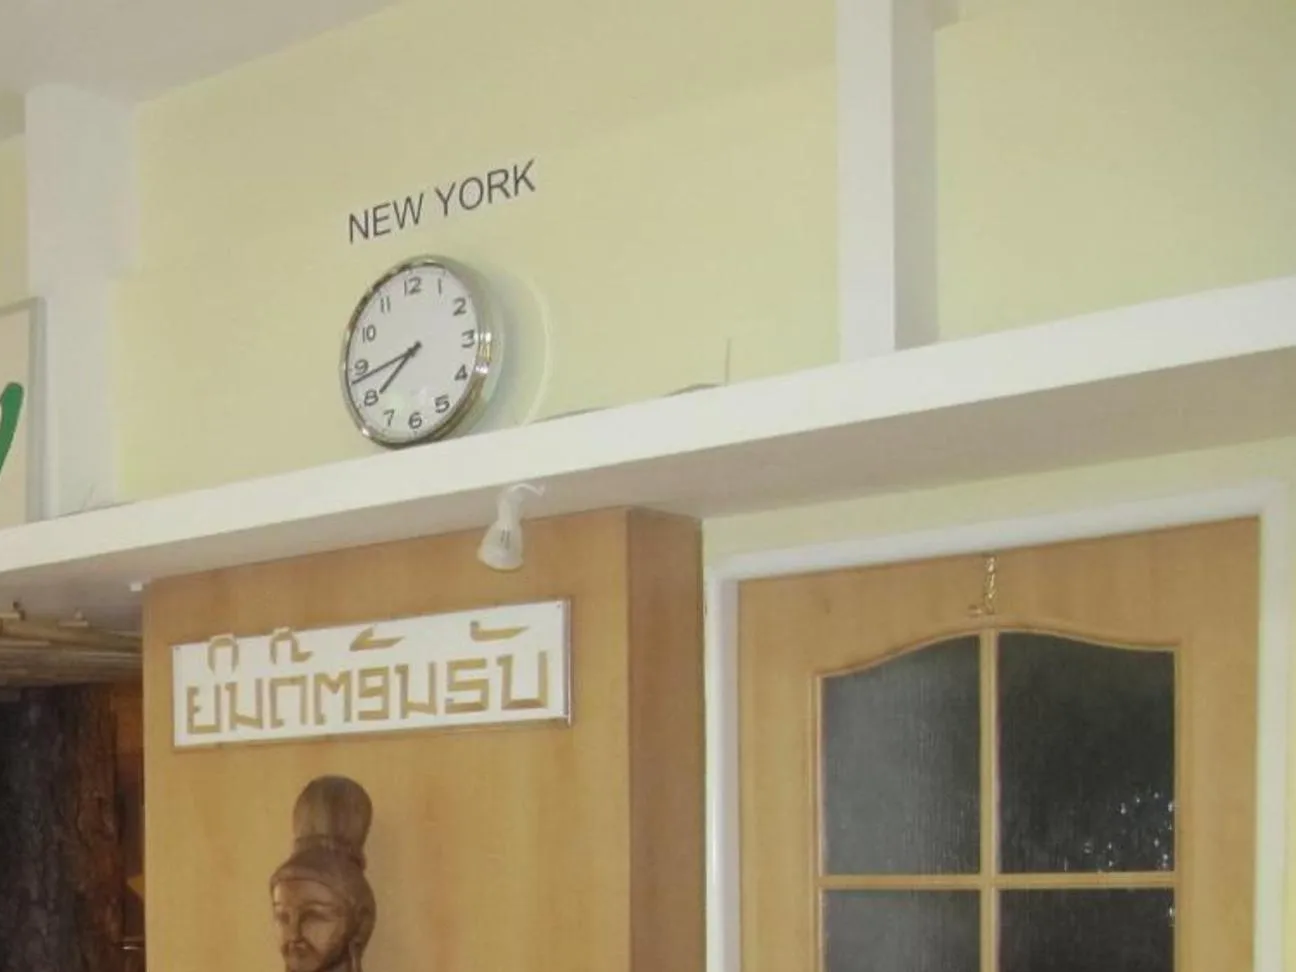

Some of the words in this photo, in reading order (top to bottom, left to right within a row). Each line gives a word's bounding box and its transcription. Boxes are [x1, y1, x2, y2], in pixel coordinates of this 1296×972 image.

[348, 193, 424, 244] NEW
[434, 159, 536, 217] YORK
[404, 276, 422, 296] 12
[380, 297, 391, 313] 11
[453, 297, 467, 316] 2
[362, 324, 377, 342] 10
[461, 329, 476, 348] 3
[354, 358, 369, 376] 9
[454, 364, 468, 381] 4
[364, 389, 379, 407] 8
[434, 394, 450, 413] 5
[383, 409, 395, 427] 7
[407, 412, 423, 429] 6
